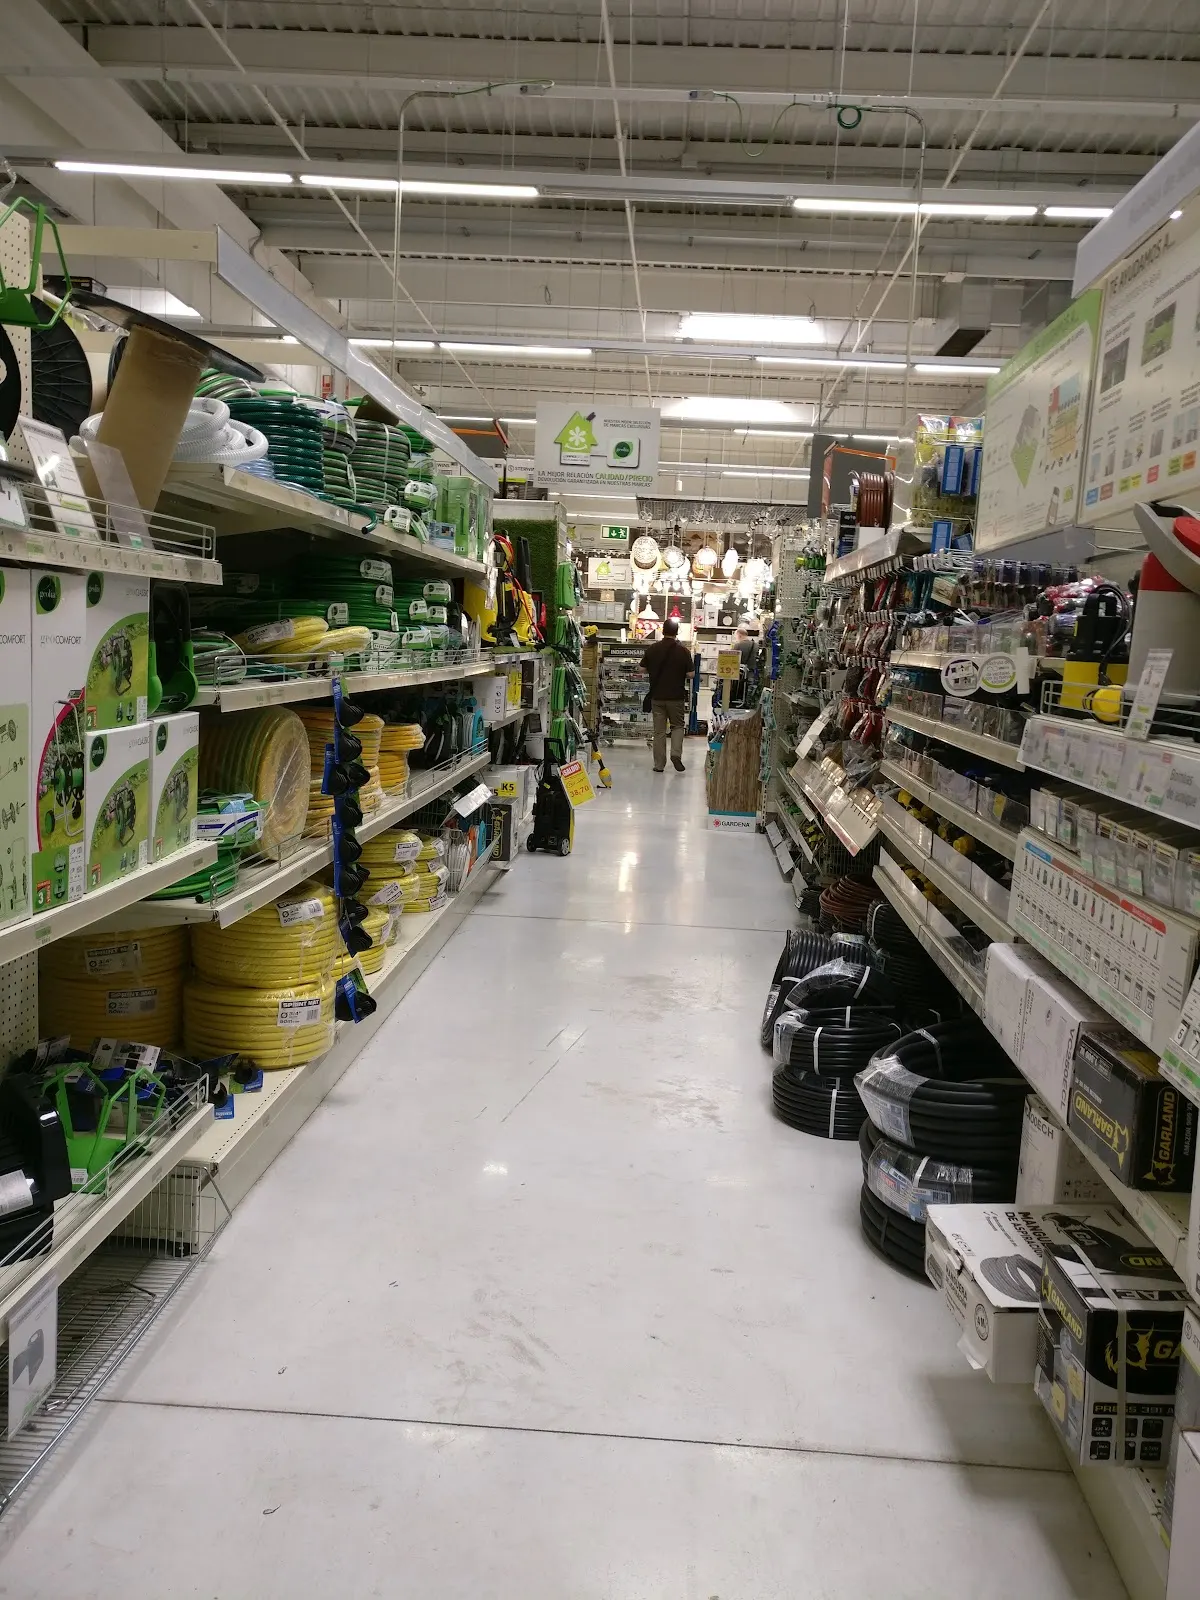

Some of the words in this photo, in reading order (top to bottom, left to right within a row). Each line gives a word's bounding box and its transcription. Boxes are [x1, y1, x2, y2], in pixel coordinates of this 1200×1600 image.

[566, 472, 594, 480] RELACIÓN
[595, 472, 653, 483] CALIDAD/PRECIO
[502, 783, 515, 792] K5
[721, 820, 751, 828] GARDENA
[38, 892, 45, 904] 3
[1075, 1095, 1114, 1138] GARLAND
[1158, 1090, 1176, 1161] GARLAND
[1004, 1211, 1019, 1222] DE
[1050, 1291, 1083, 1340] GARLAND
